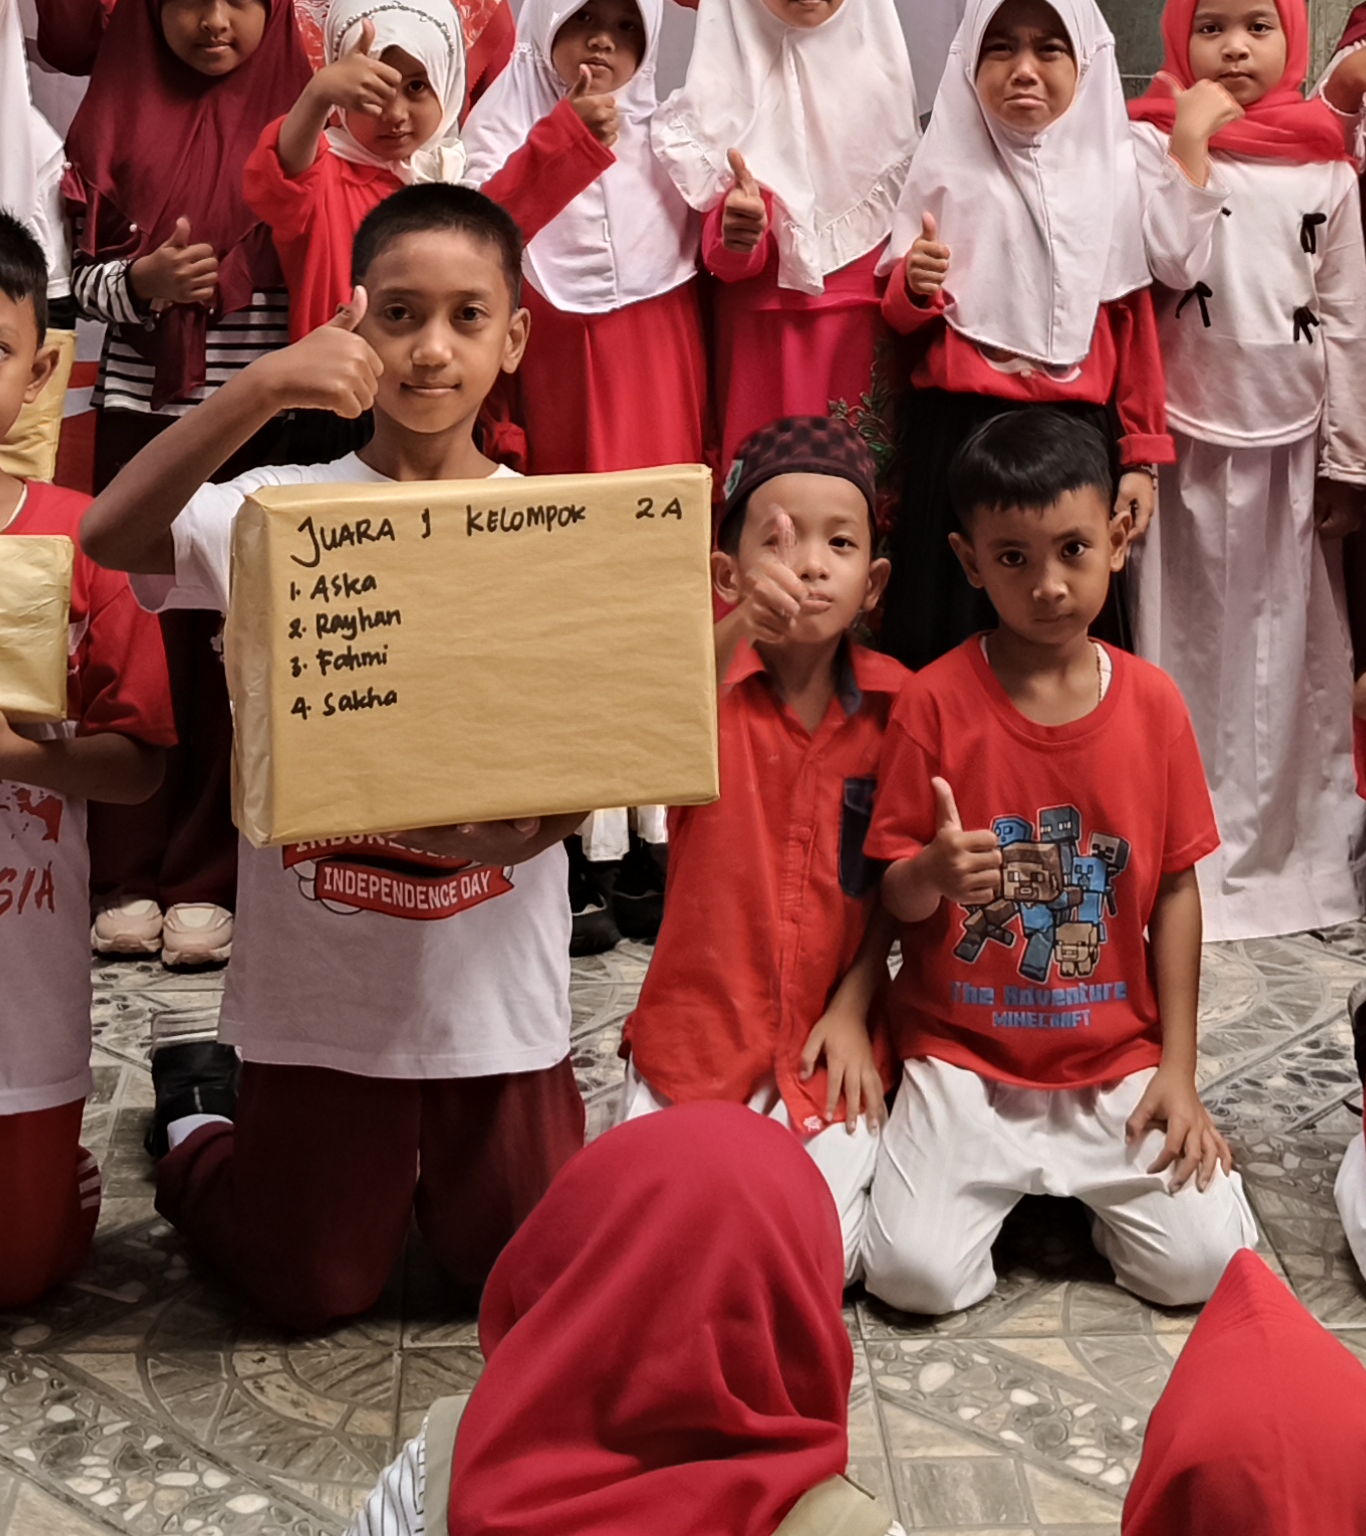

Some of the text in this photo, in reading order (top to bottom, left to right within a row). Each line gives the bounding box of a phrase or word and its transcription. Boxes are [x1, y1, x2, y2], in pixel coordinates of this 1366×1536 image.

[290, 516, 395, 568] JUARA
[466, 504, 586, 536] KELOMPOK
[310, 572, 377, 601] Aska
[316, 645, 389, 676] Fahmi
[322, 686, 398, 716] Sakha
[324, 867, 491, 910] INDEPENDENCE DAY
[949, 981, 1128, 1007] The Adventure
